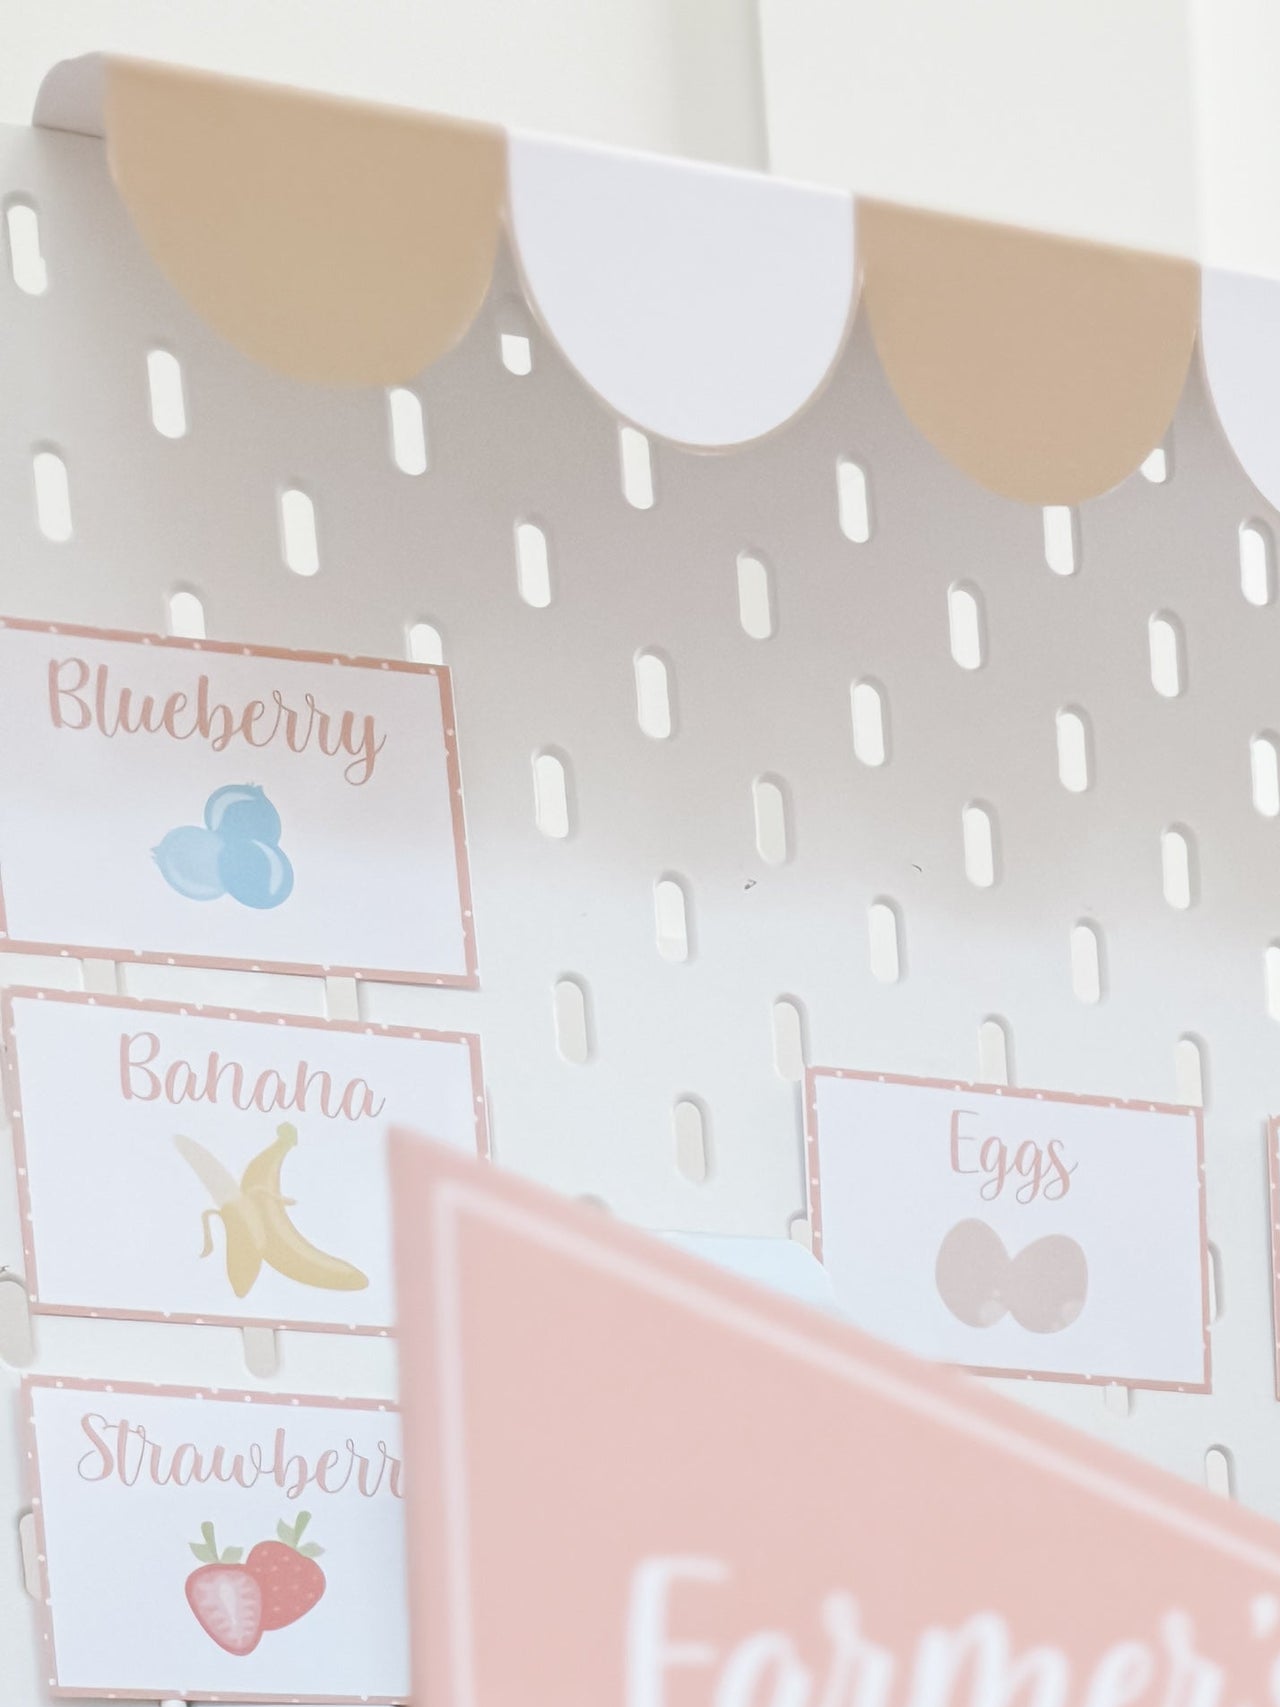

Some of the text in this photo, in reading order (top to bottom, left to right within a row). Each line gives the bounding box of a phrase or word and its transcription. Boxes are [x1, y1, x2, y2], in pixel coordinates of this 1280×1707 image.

[46, 656, 388, 786] Blueberry
[118, 1030, 386, 1122] Banana
[949, 1109, 1080, 1204] Eggs
[76, 1411, 403, 1500] Strawberr
